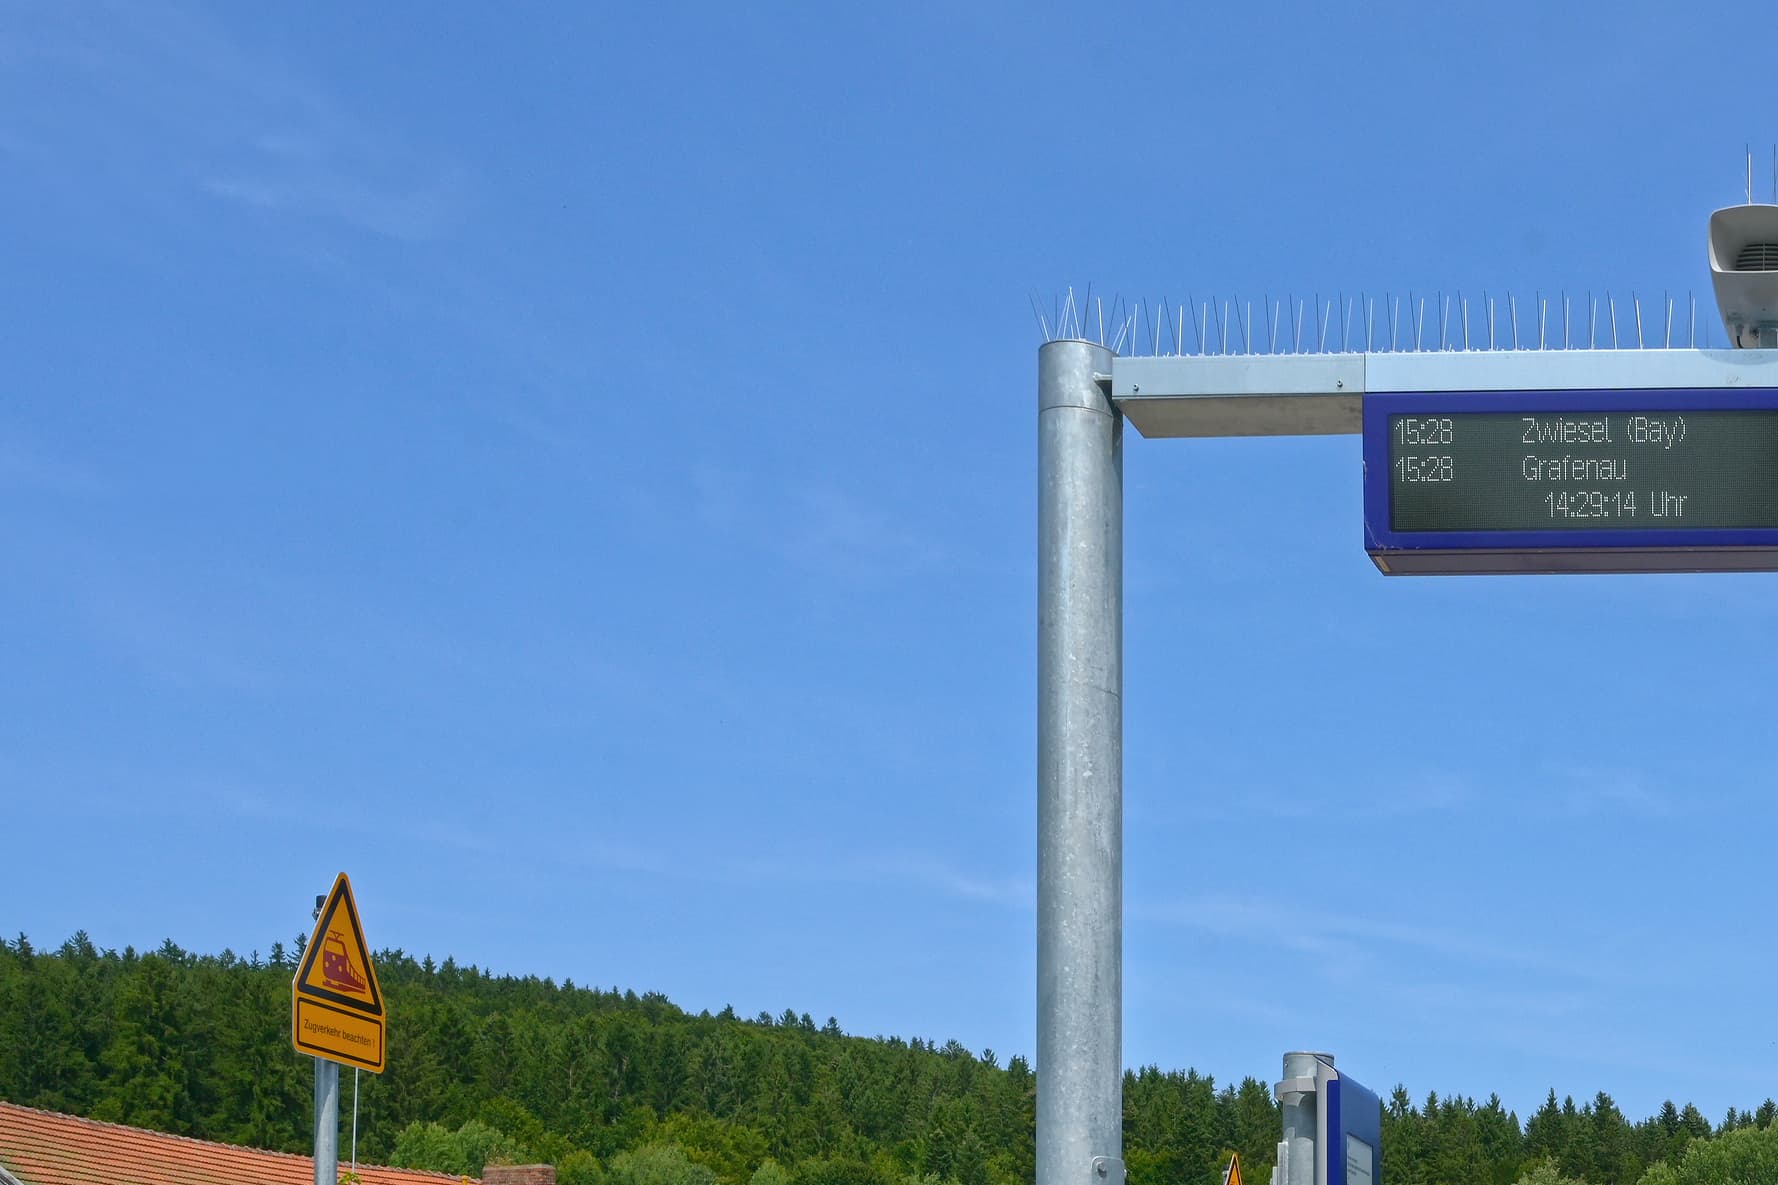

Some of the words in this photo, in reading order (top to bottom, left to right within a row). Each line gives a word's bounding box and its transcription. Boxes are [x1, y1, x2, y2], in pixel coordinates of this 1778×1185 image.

[1395, 418, 1453, 445] 15:28
[1522, 416, 1613, 444] Zwiesel
[1627, 416, 1687, 450] (Bay)
[1395, 456, 1453, 482] 15:28
[1522, 455, 1626, 481] Grafenau
[1544, 491, 1637, 518] 14:29:14
[1651, 490, 1688, 517] Uhr
[303, 1018, 341, 1038] Zugverkehr
[342, 1029, 371, 1047] beachten
